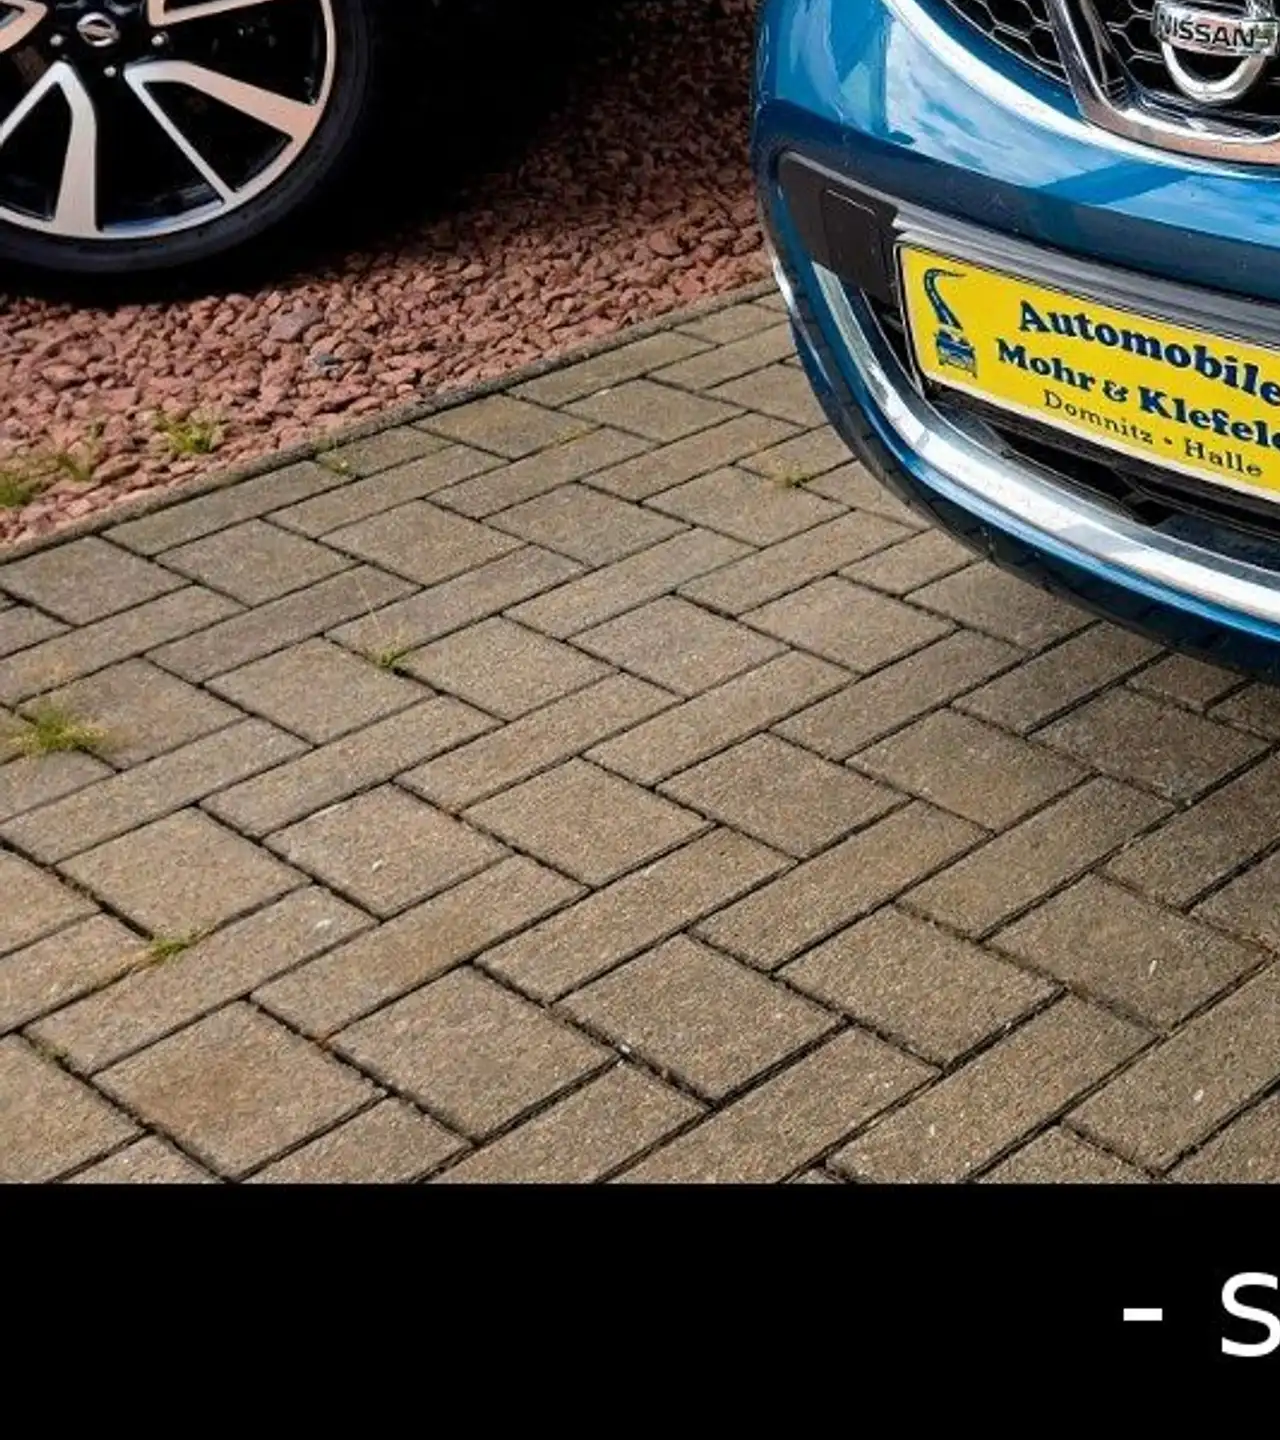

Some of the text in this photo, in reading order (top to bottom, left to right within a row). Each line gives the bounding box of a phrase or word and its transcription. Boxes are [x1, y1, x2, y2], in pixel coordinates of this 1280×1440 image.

[1158, 12, 1255, 49] NISSAN
[996, 337, 1096, 392] Mohr
[1102, 380, 1129, 403] &
[1043, 389, 1154, 445] Domnitz
[1183, 436, 1263, 478] Halle
